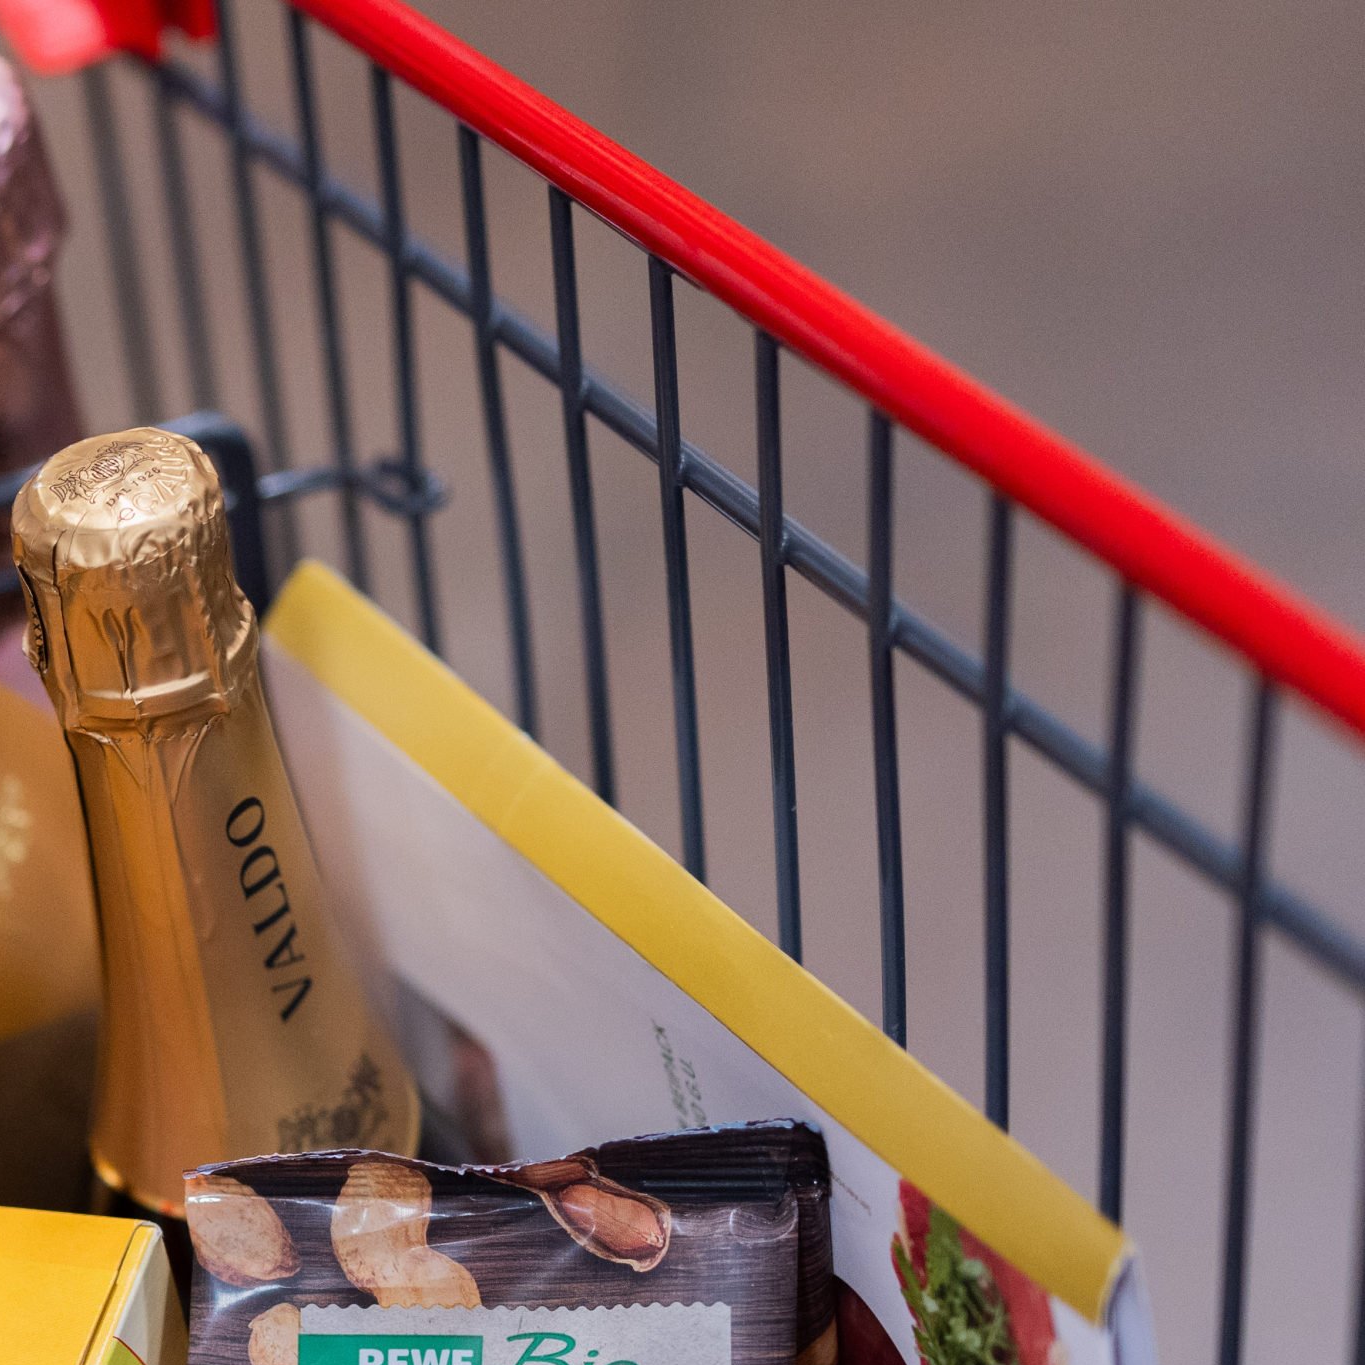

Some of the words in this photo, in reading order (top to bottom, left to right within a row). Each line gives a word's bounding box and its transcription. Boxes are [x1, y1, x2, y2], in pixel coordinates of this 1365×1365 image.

[106, 487, 132, 507] DAL
[132, 467, 162, 487] 1926
[225, 796, 315, 1022] VALDO
